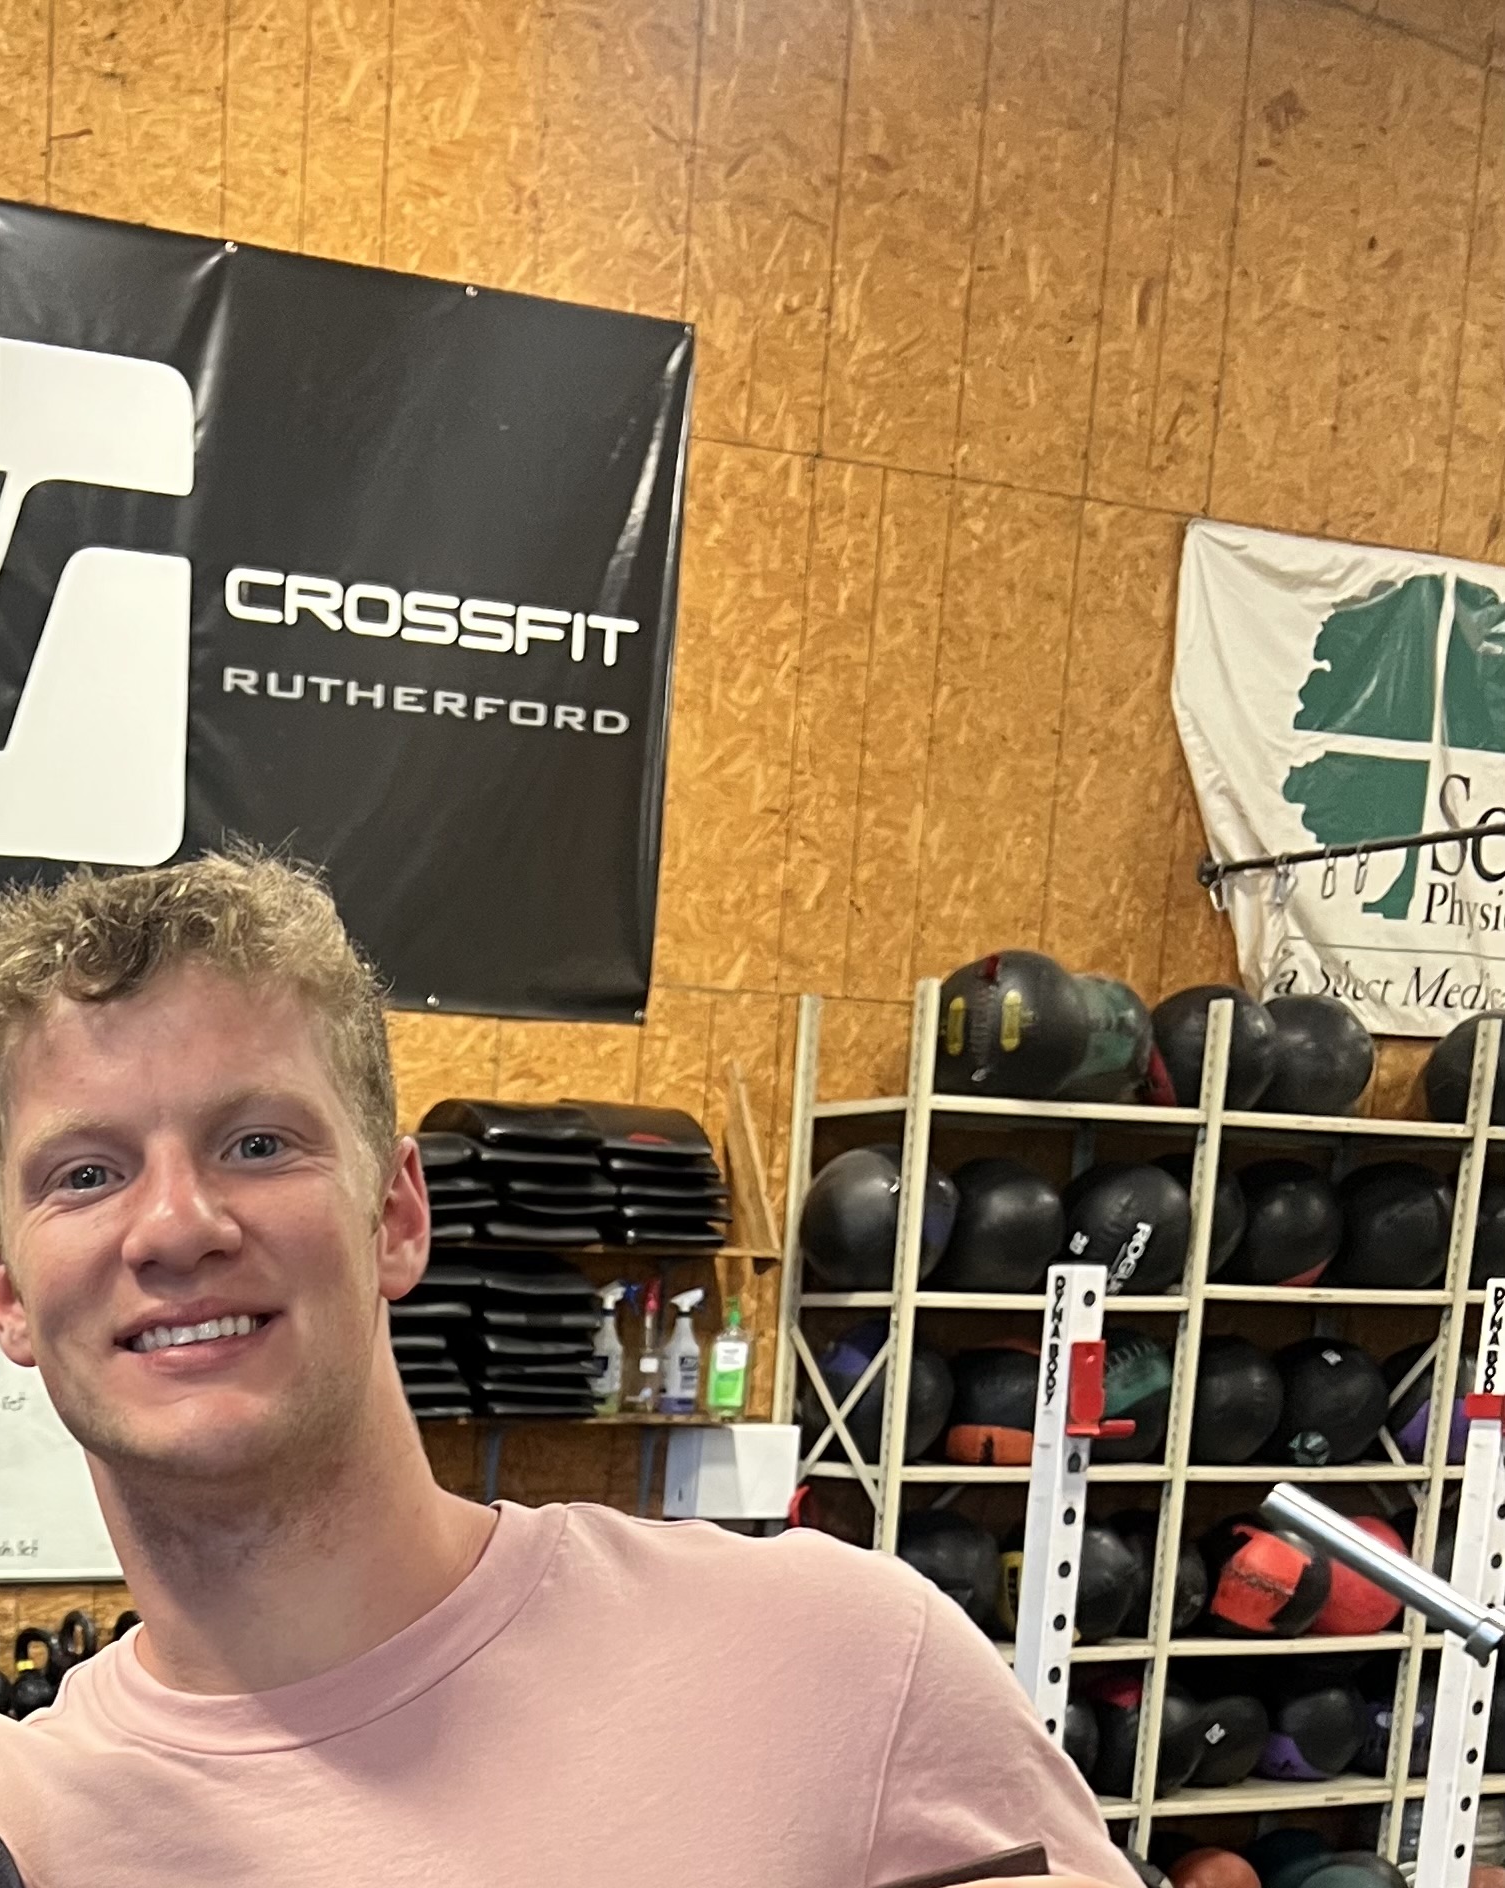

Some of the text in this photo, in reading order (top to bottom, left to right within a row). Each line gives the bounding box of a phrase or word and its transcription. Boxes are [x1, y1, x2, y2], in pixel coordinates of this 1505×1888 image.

[225, 567, 640, 667] CROSSFIT
[222, 666, 631, 735] RUTHERFORD
[1422, 882, 1505, 938] Physi
[1483, 1287, 1505, 1393] DYNABOD
